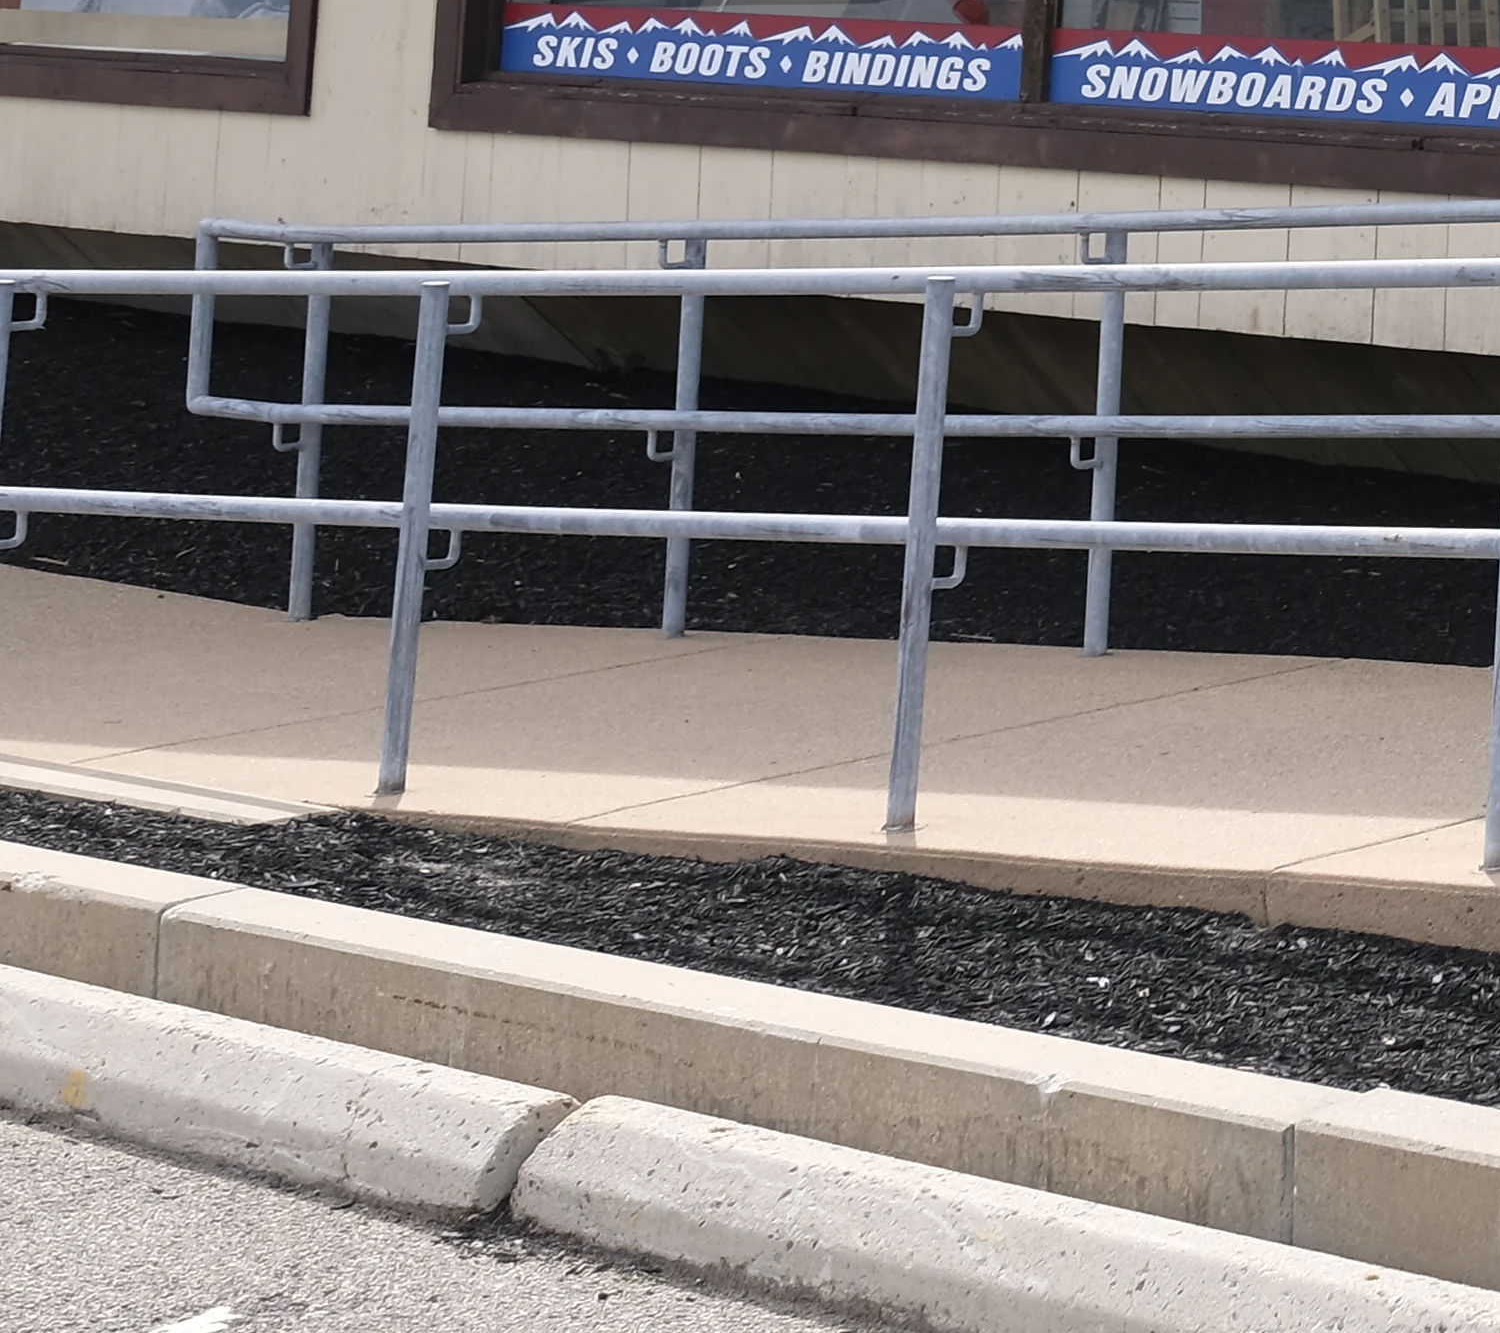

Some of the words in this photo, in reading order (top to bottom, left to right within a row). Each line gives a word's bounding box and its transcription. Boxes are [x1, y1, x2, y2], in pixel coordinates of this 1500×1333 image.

[533, 34, 617, 72] SKIS
[650, 40, 772, 81] BOOTS
[802, 48, 992, 93] BINDINGS
[1080, 64, 1389, 114] SNOWBOARDS
